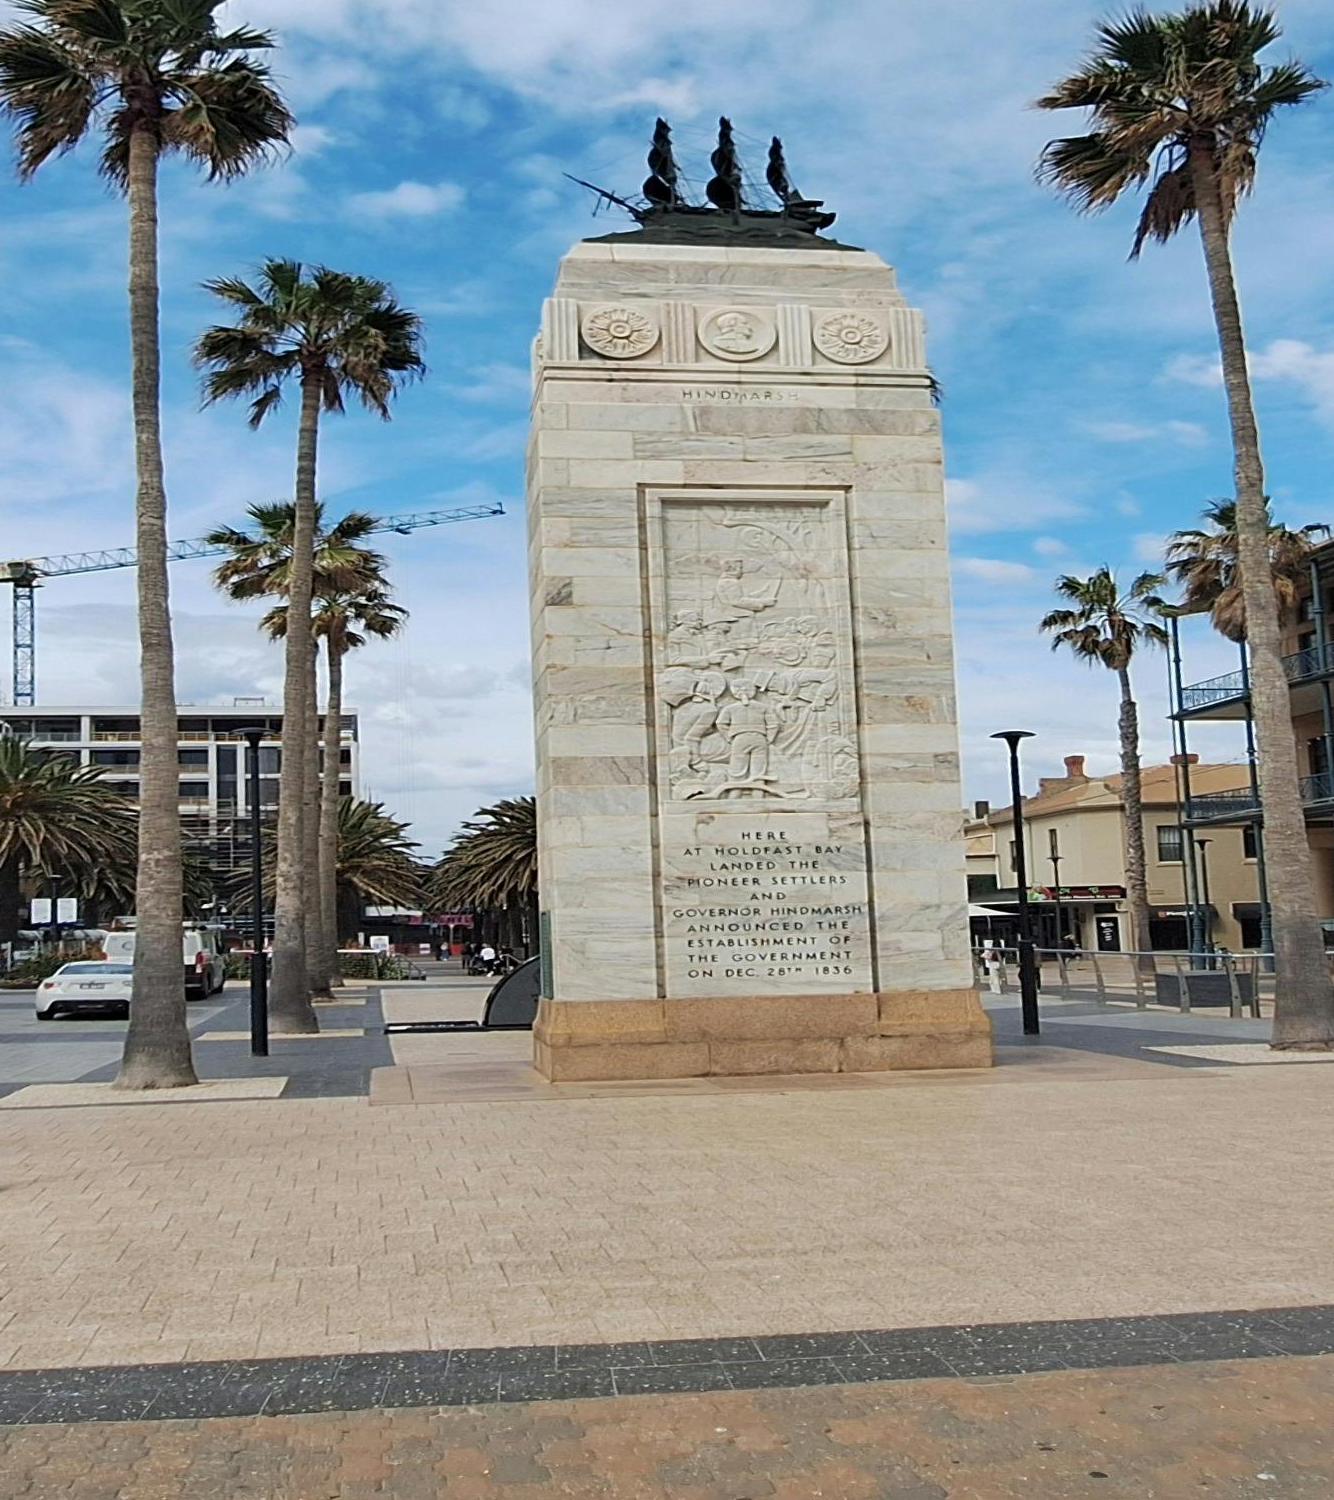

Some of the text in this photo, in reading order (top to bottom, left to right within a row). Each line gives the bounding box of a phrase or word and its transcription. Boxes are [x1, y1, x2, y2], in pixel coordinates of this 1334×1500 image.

[682, 389, 799, 401] HINDMARSH
[741, 831, 787, 841] HERE
[683, 845, 843, 857] AT HOLDFAST BAY
[710, 860, 820, 872] LANDED THE
[687, 875, 847, 888] PIONEER SETTLERS
[750, 892, 787, 901] AND
[673, 905, 863, 919] GOVERNOR HINDMARSH
[687, 920, 850, 934] ANNOUNCED THE
[687, 935, 852, 949] ESTABLISHMENT OF
[688, 951, 853, 964] THE GOVERNMENT
[687, 969, 713, 979] ON
[725, 968, 760, 978] DEC.
[815, 966, 853, 976] 1836
